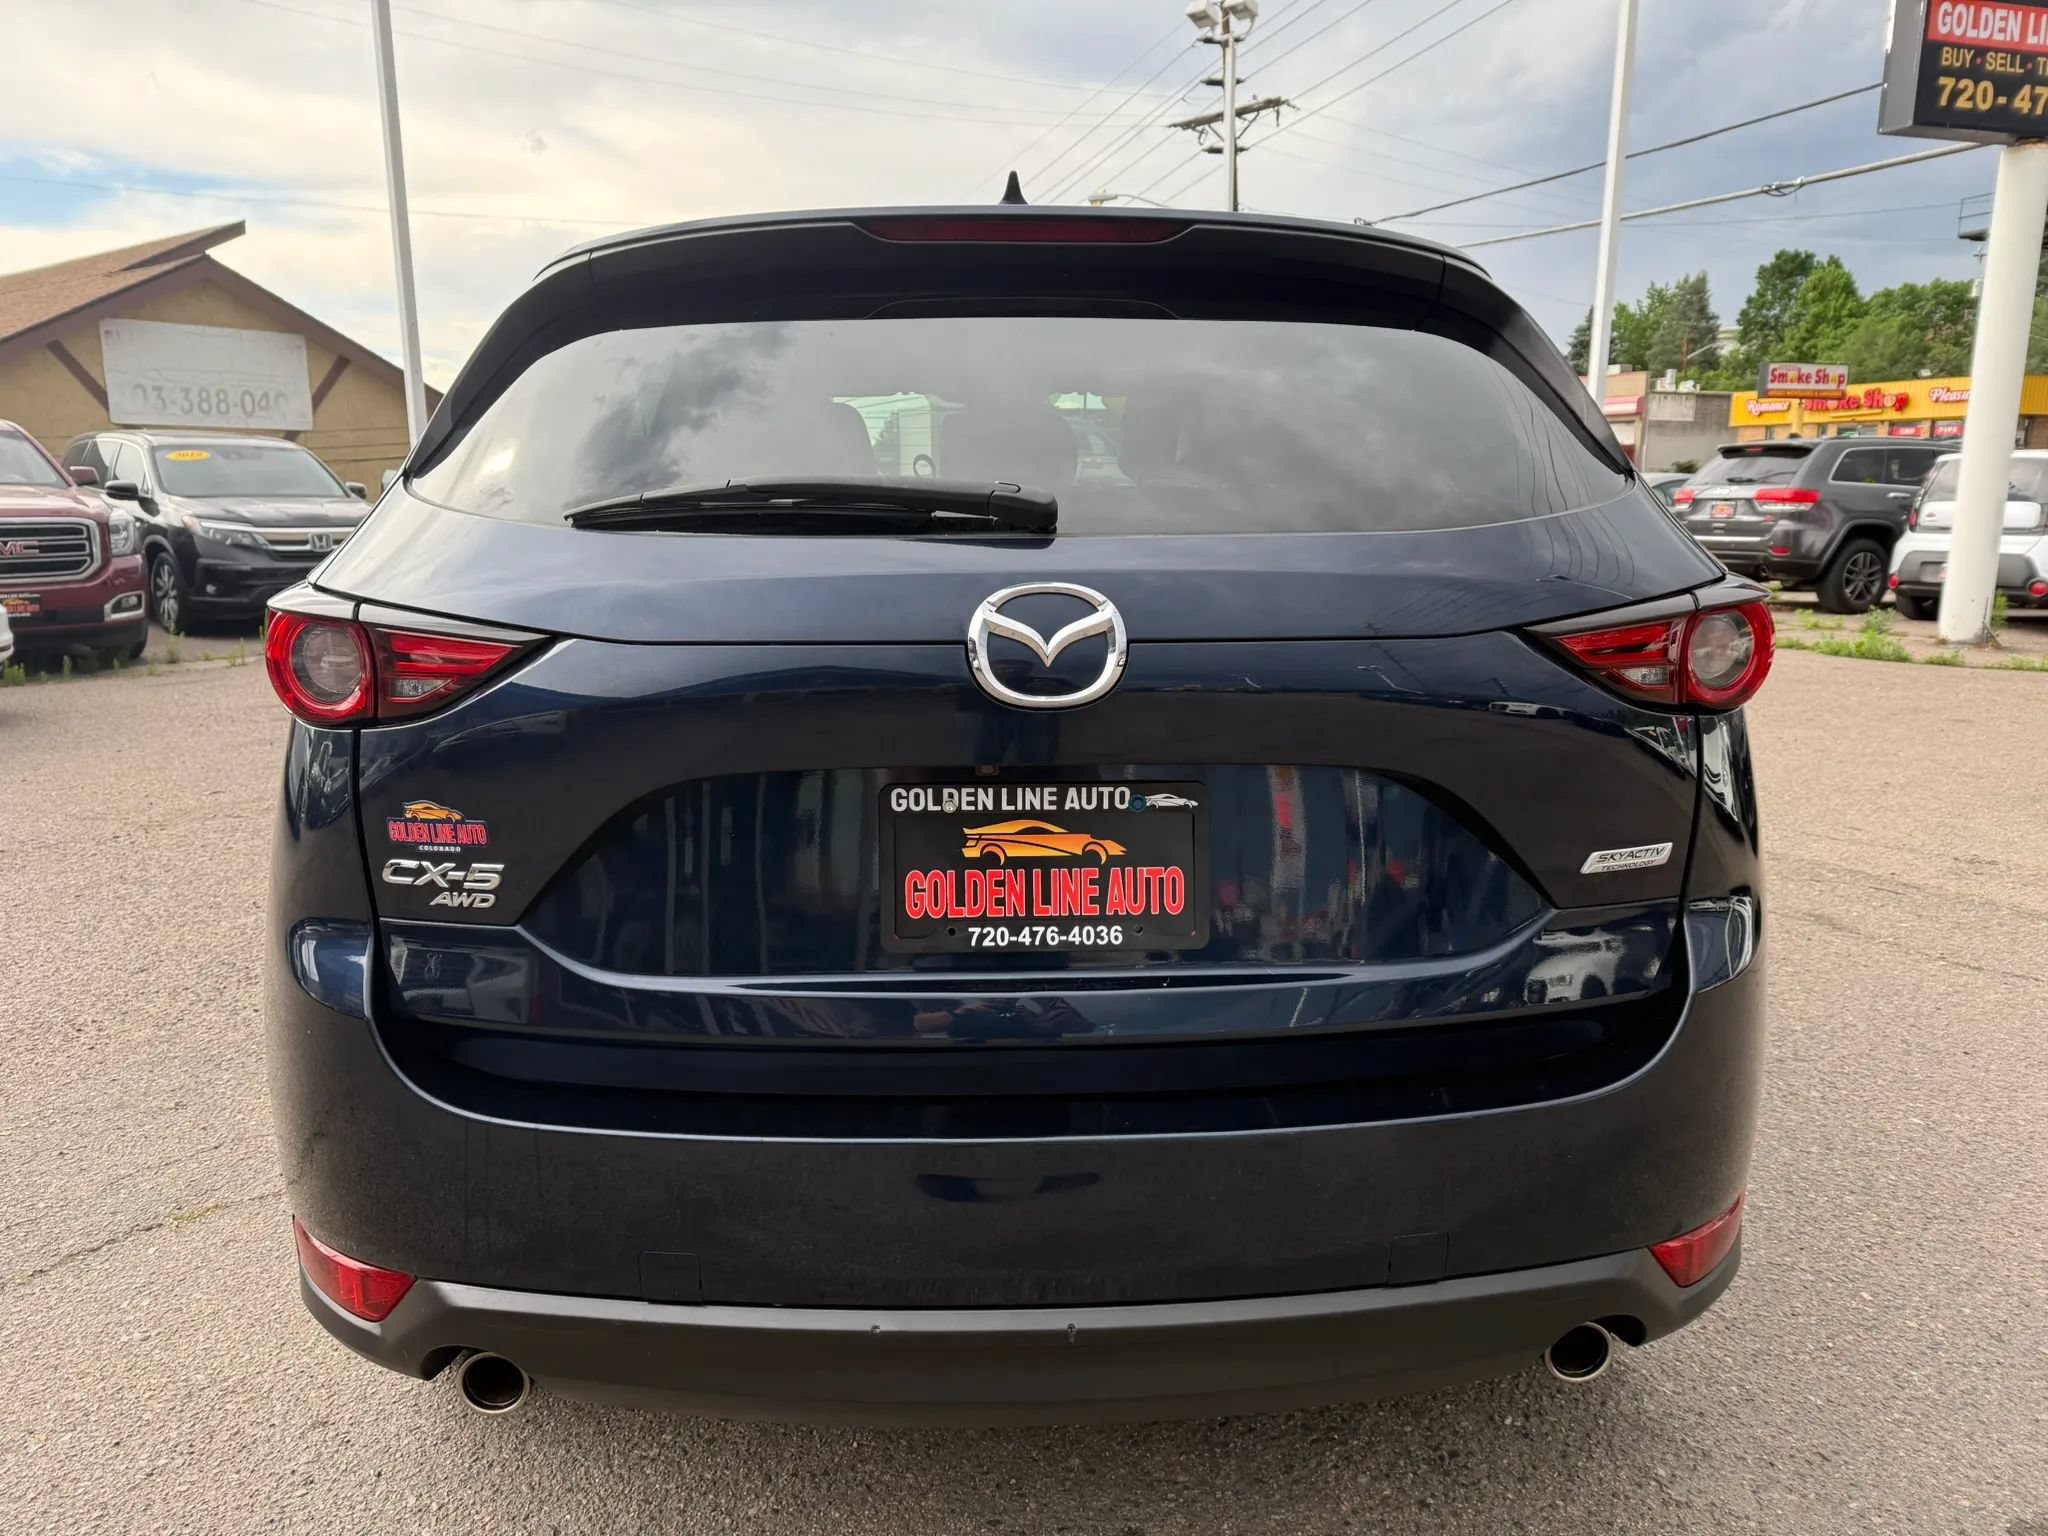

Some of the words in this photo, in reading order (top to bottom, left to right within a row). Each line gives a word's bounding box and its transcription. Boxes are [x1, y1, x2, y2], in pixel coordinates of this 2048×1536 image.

[1938, 2, 2022, 42] GOLDEN
[2027, 13, 2048, 45] LI
[1942, 47, 1975, 67] BUY
[1986, 52, 2024, 72] SELL
[1930, 386, 1971, 403] Pleasu
[890, 787, 994, 813] GOLDEN
[1001, 786, 1058, 811] LINE
[1064, 786, 1131, 811] AUTO
[389, 822, 430, 843] GOLDEN
[430, 823, 457, 844] LINE
[458, 824, 488, 845] AUTO
[1597, 847, 1665, 862] SKYACTIV
[1602, 860, 1656, 871] TECHNOLOGY
[382, 859, 504, 890] CX-5
[430, 892, 495, 909] AWD
[904, 868, 1026, 919] GOLDEN
[1032, 867, 1101, 917] LINE
[1106, 865, 1185, 916] AUTO
[967, 925, 1124, 947] 720-476-4036
